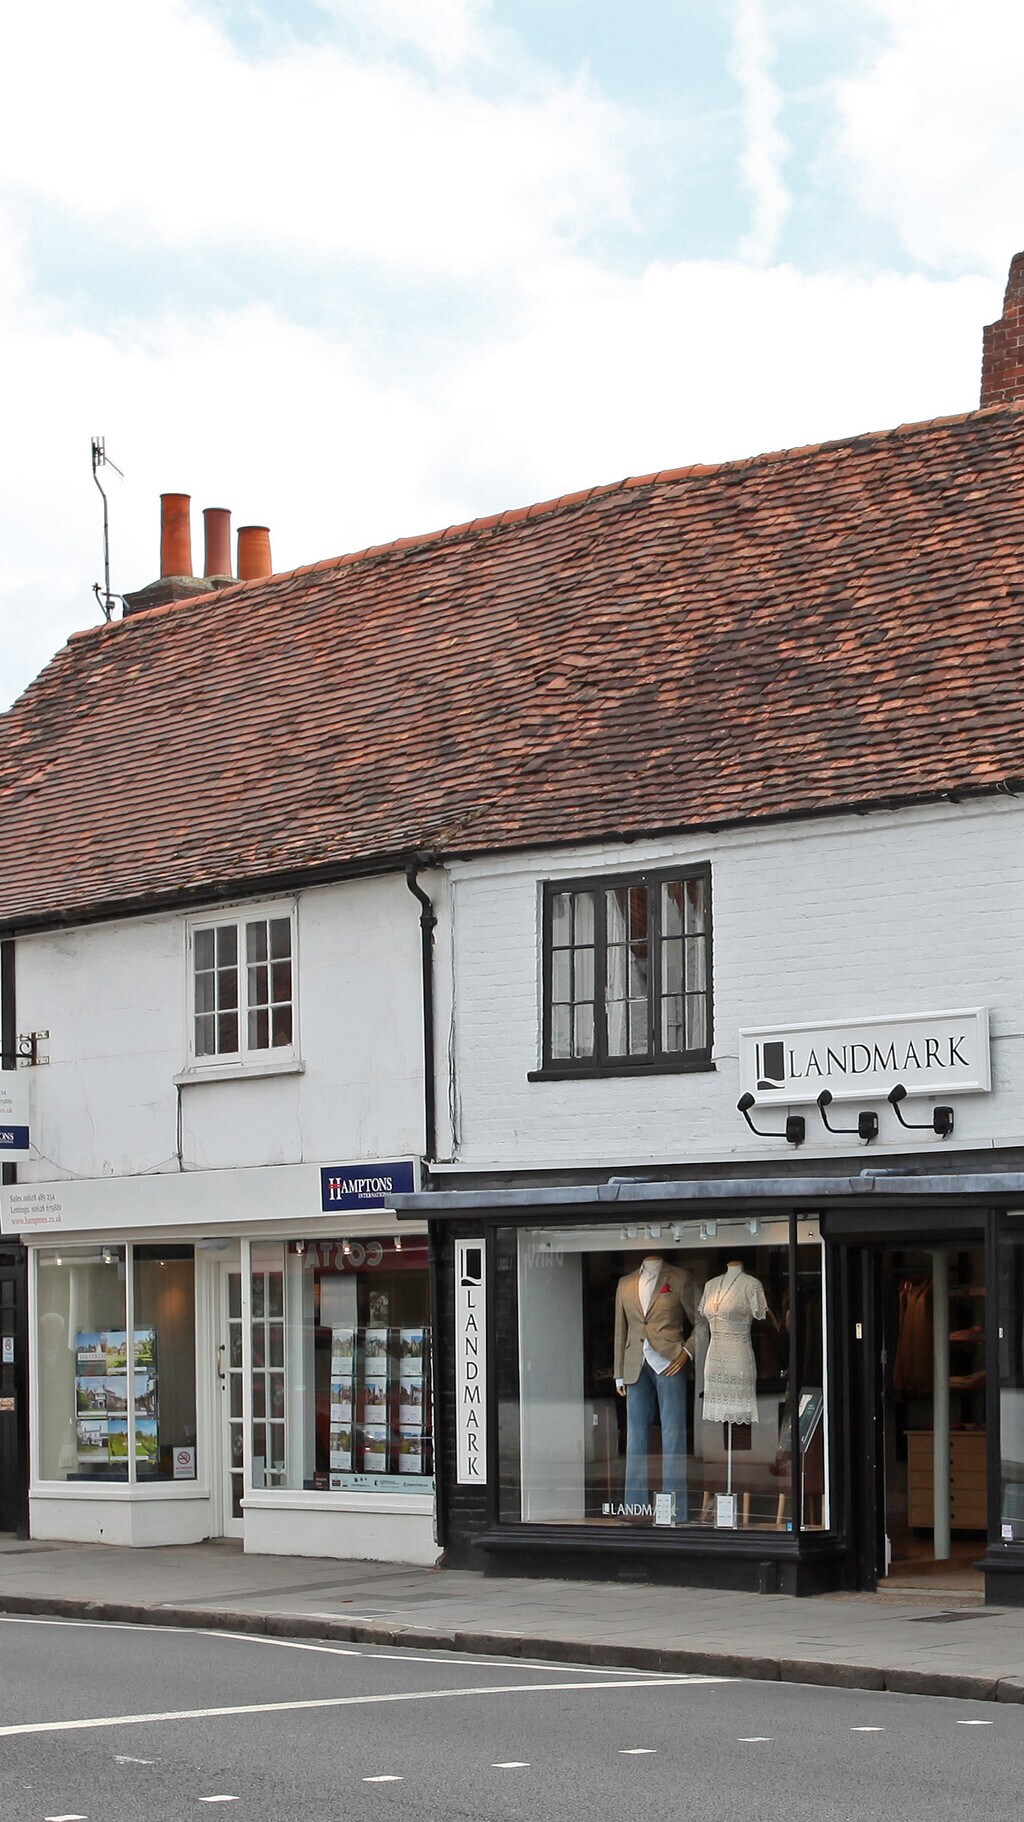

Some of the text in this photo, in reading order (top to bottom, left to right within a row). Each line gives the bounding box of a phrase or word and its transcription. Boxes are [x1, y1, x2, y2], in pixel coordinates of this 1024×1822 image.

[789, 1035, 970, 1078] LANDMARK
[328, 1177, 393, 1200] HAMPTONS
[464, 1290, 481, 1476] LANDMARK
